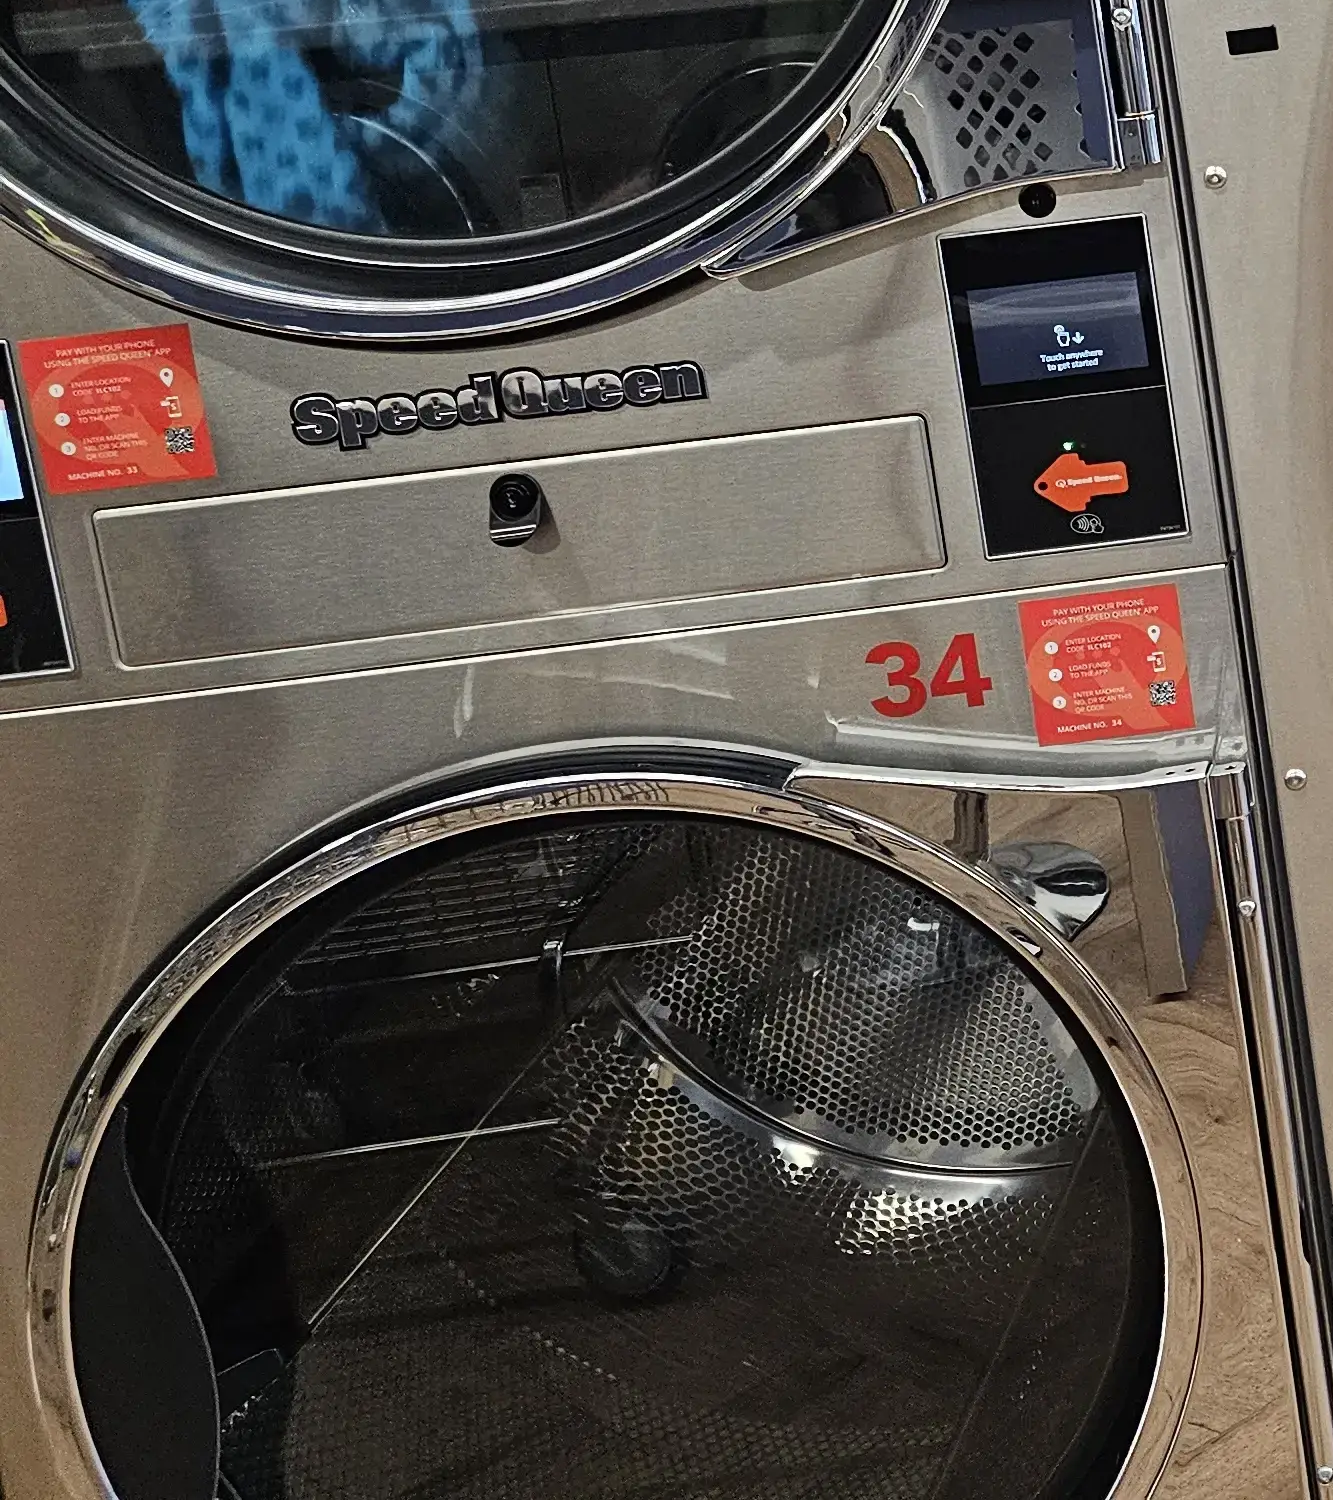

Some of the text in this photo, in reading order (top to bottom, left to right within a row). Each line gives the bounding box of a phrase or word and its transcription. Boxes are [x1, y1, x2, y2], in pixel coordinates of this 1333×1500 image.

[1040, 350, 1103, 362] Touch anywhere
[1058, 362, 1070, 371] get
[1071, 358, 1098, 368] started
[290, 360, 708, 451] Speed Queen
[1053, 598, 1145, 616] PAY WITH YOUR PHONE
[1041, 617, 1068, 627] USING
[1068, 615, 1085, 624] THE
[1085, 612, 1111, 621] SPEED
[1143, 606, 1159, 615] APP
[1065, 633, 1121, 646] ENTER LOCATION
[1066, 645, 1084, 653] CODE
[1069, 660, 1112, 672] LOAD FUNDS
[865, 633, 993, 717] 34
[1072, 686, 1125, 698] ENTER MACHINE
[1099, 695, 1117, 703] SCAN
[1118, 692, 1133, 700] THIS
[1086, 704, 1104, 712] CODE
[1057, 722, 1092, 733] MACHINE
